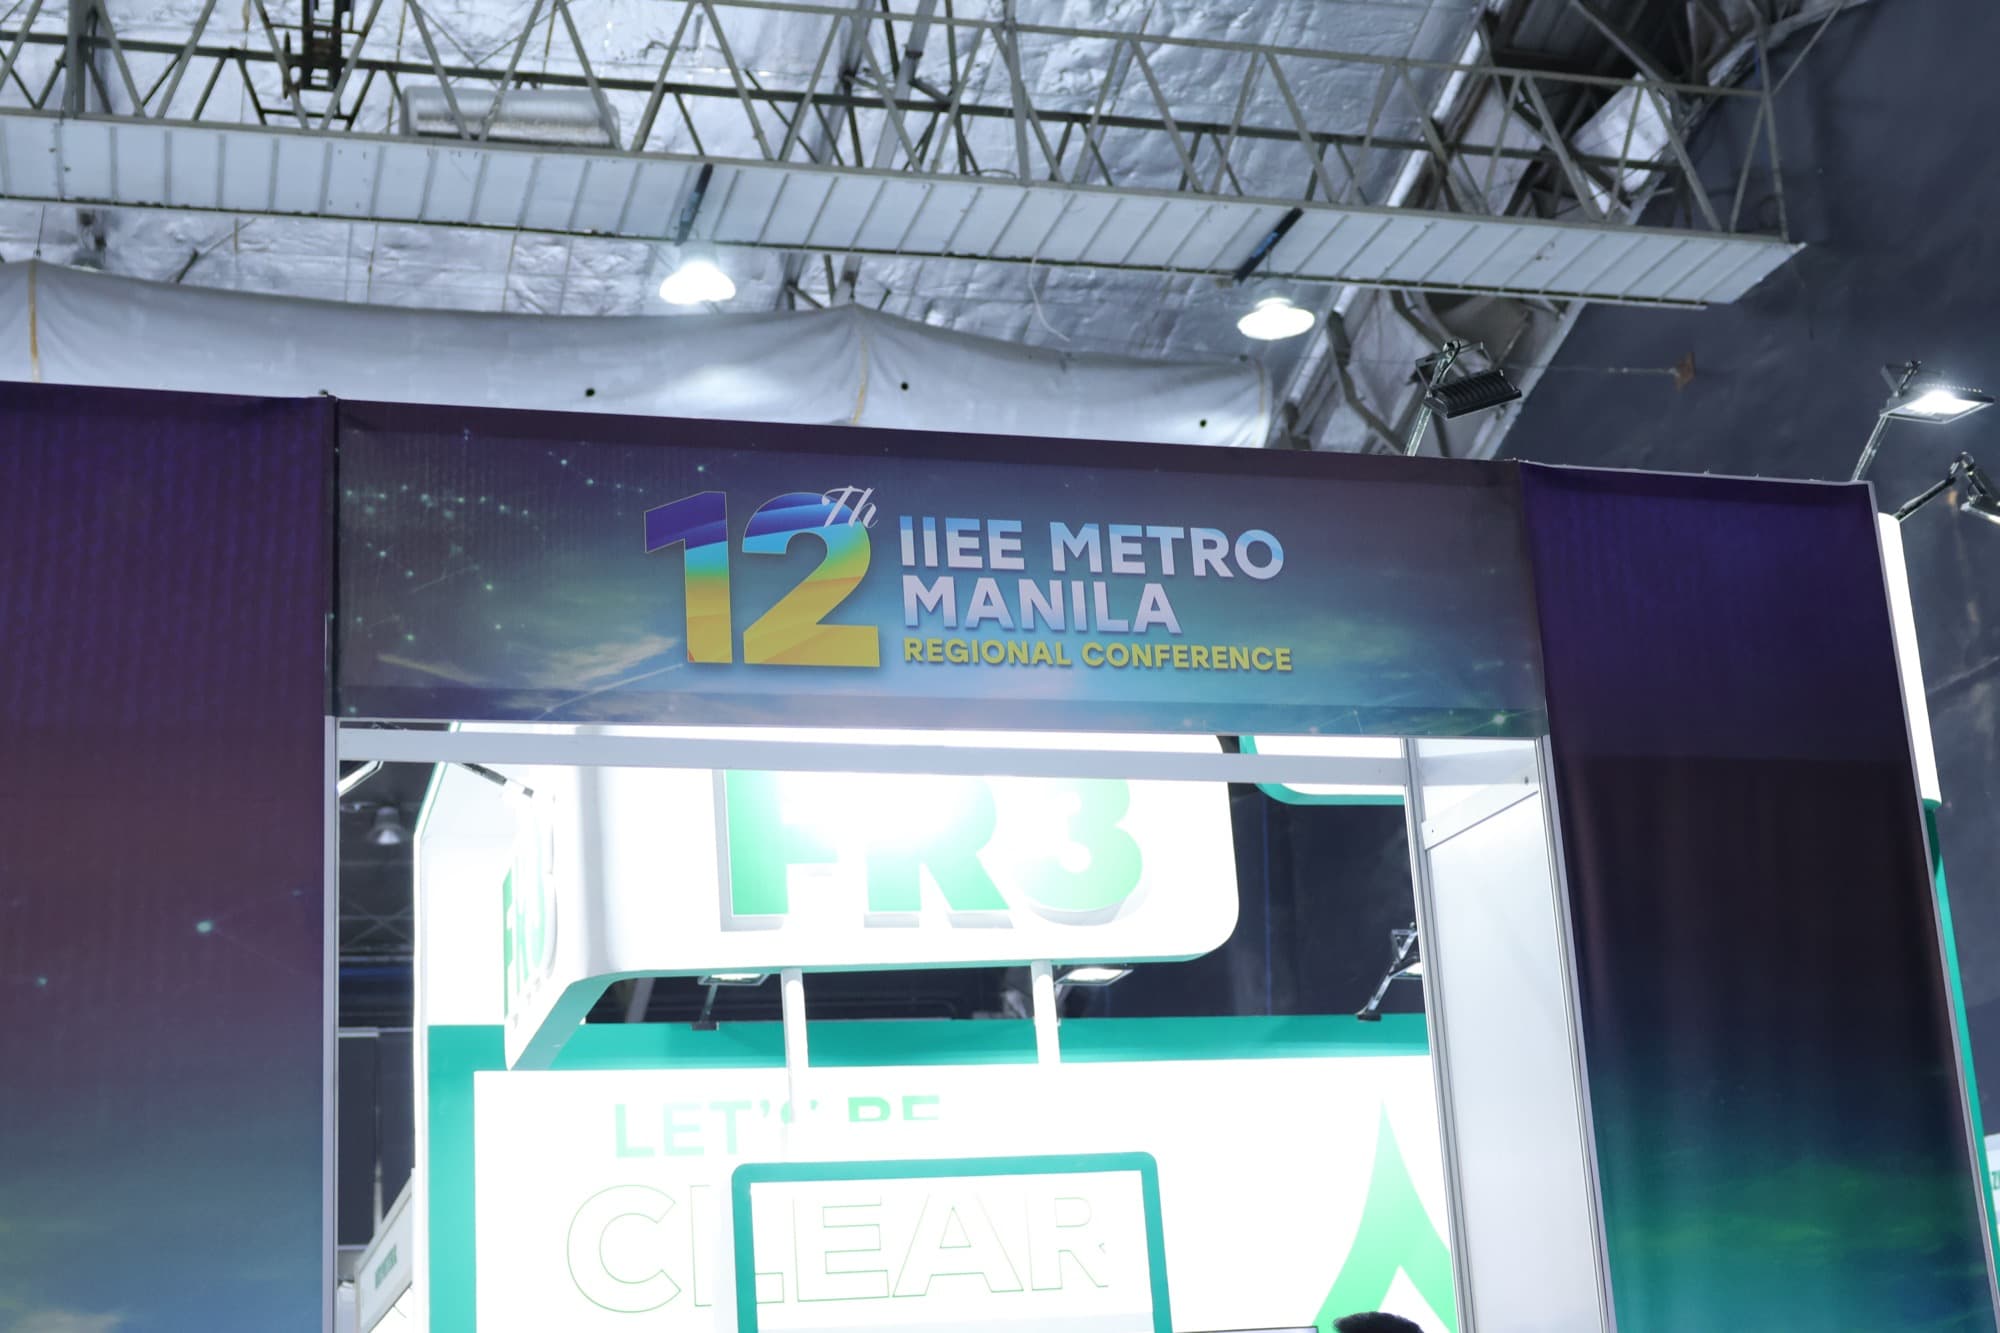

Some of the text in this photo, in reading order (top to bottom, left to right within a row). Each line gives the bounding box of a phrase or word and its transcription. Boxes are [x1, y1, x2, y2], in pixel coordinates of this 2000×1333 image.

[900, 515, 1285, 581] IIEE METRO
[901, 574, 1183, 634] MANILA
[903, 637, 1293, 672] REGIONAL CONFERENCE
